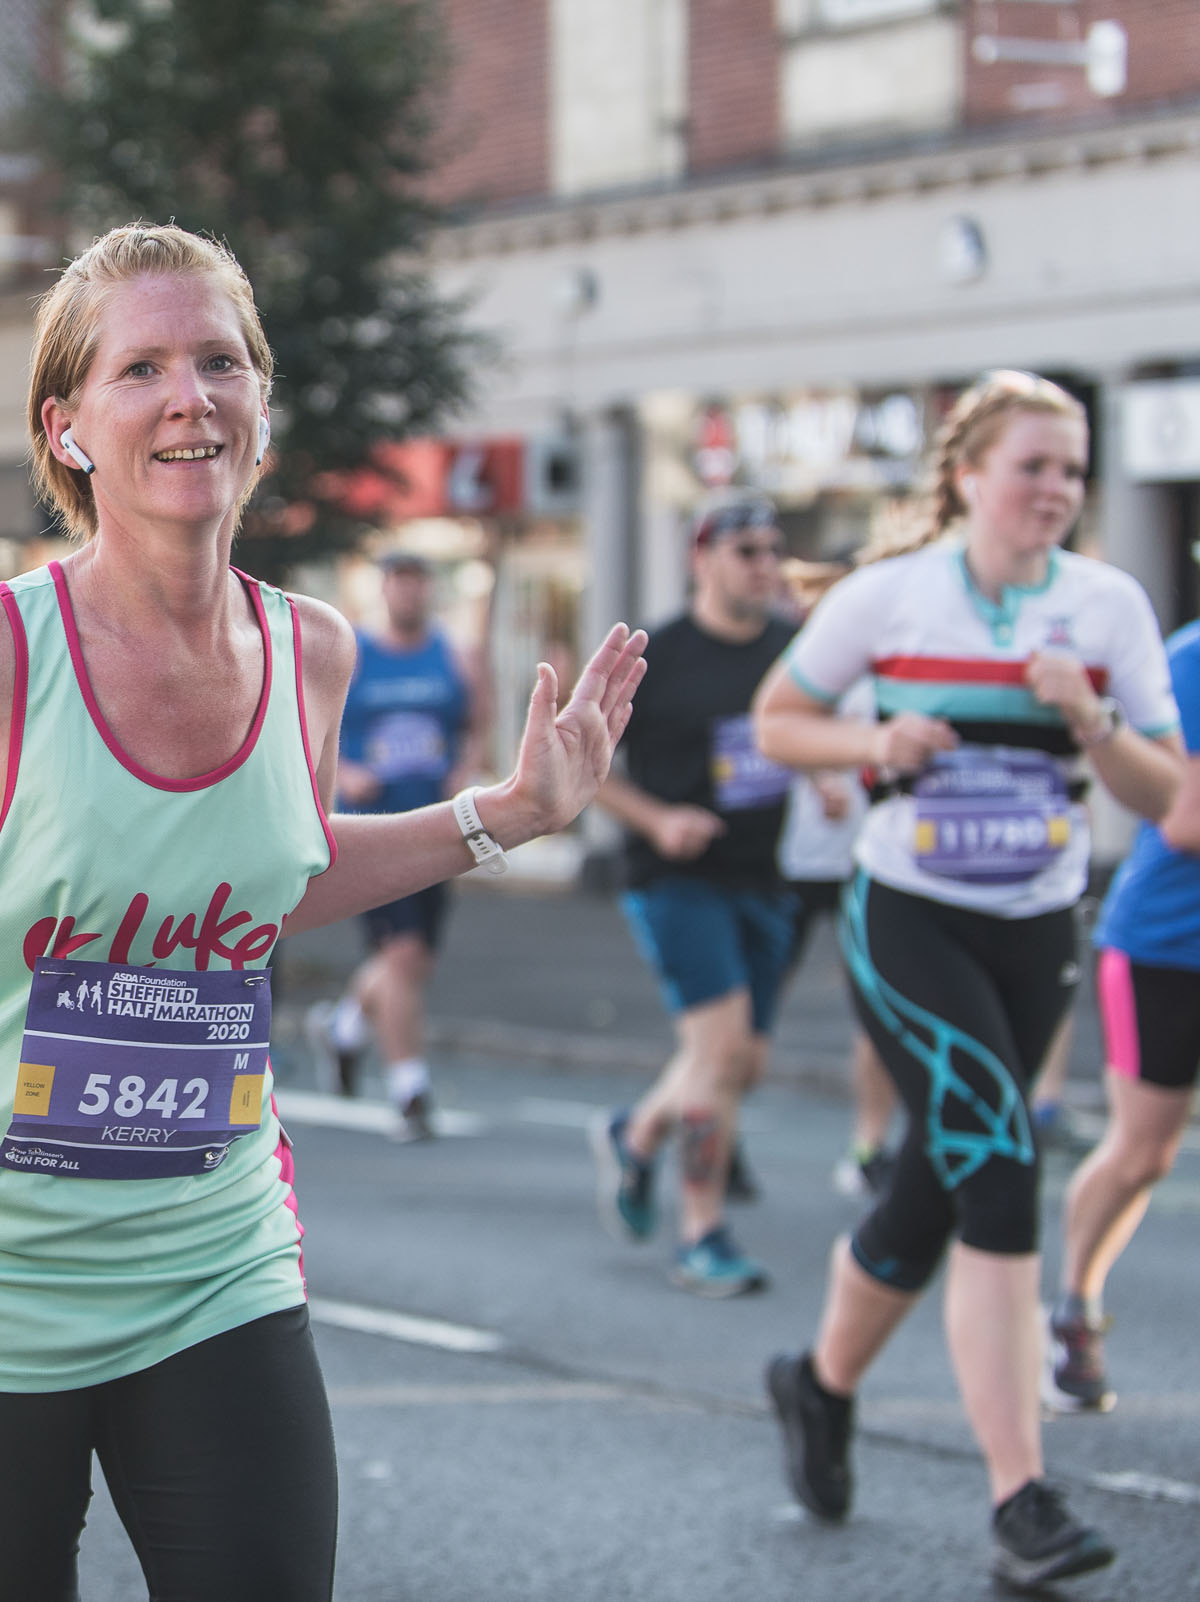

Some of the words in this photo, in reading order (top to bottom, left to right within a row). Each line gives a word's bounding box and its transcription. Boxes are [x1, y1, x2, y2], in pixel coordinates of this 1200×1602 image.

[112, 972, 138, 984] ASDA
[139, 975, 187, 987] Foundation
[109, 981, 195, 1004] SHEFFIELD
[107, 1000, 154, 1018] HALF
[155, 1005, 253, 1021] MARATHON
[206, 1024, 250, 1040] 2020
[233, 1053, 249, 1070] M
[23, 1081, 45, 1089] YELLOW
[77, 1073, 209, 1119] 5842
[101, 1126, 177, 1143] KERRY
[33, 1157, 58, 1168] FOR
[59, 1160, 80, 1170] ALL
